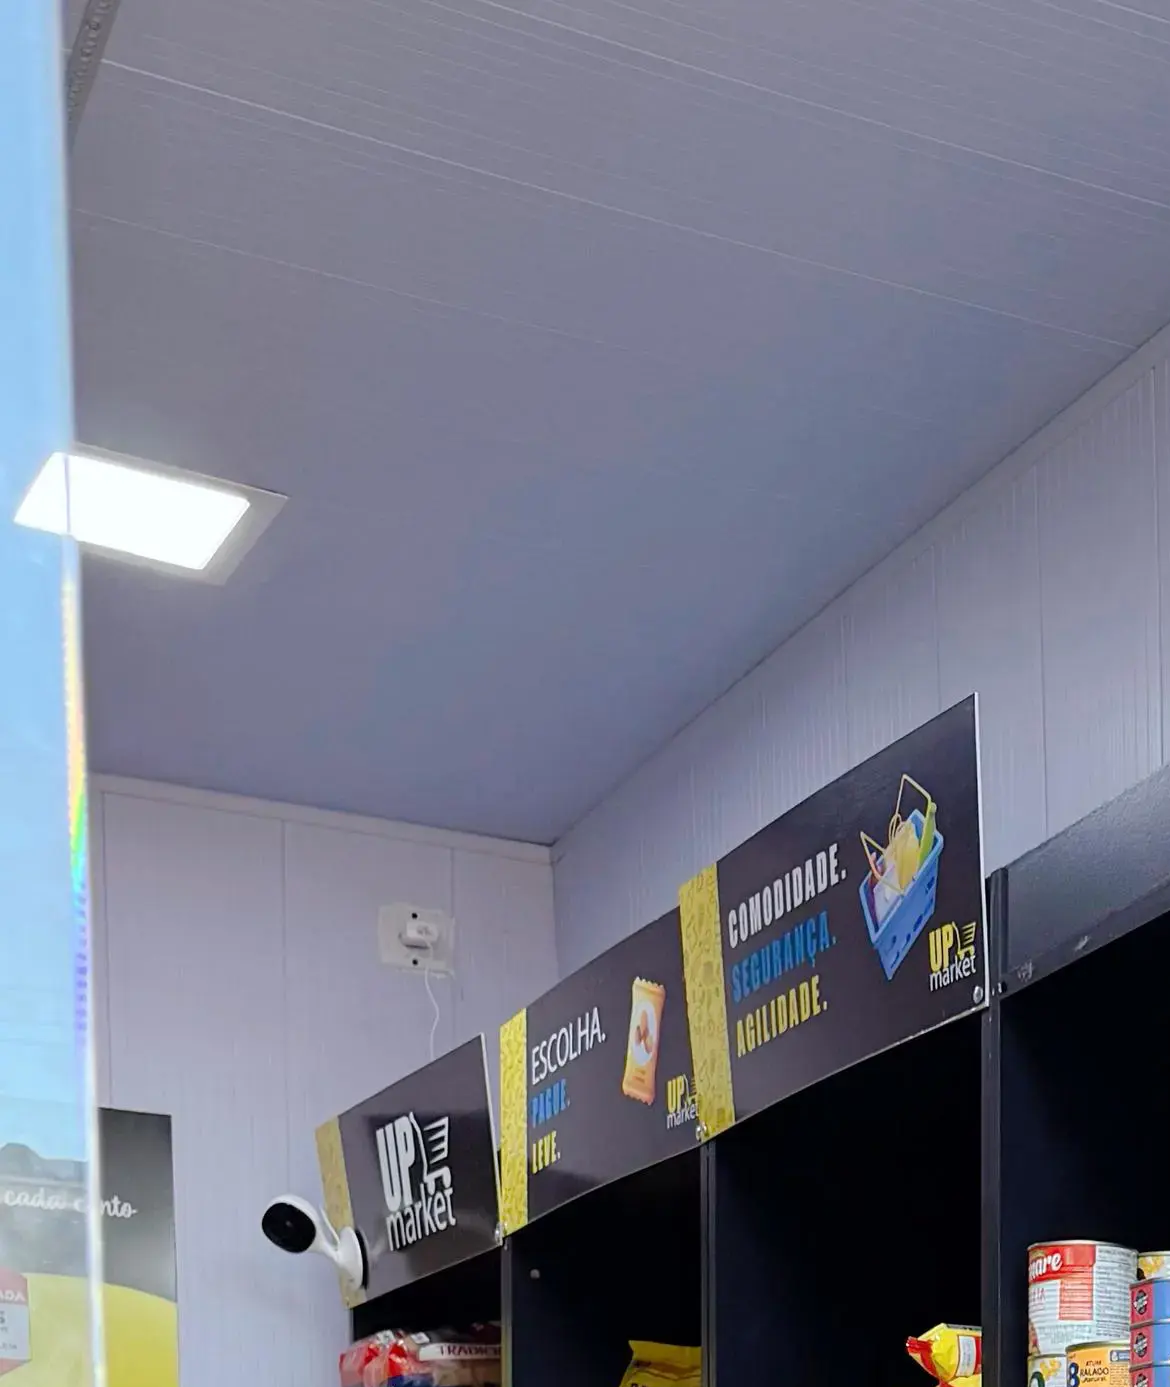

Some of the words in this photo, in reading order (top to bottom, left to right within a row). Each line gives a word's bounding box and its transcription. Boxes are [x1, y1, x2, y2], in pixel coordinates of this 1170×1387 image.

[728, 843, 847, 949] COMODIDADE.
[731, 911, 837, 1003] SEGURANÇA.
[927, 923, 955, 972] UP
[929, 953, 977, 992] market
[530, 1007, 606, 1085] ESCOLHA.
[736, 975, 828, 1058] AGILIDADE.
[666, 1078, 685, 1113] UP
[375, 1113, 416, 1213] UP
[531, 1131, 561, 1174] LEVE.
[385, 1187, 457, 1252] market
